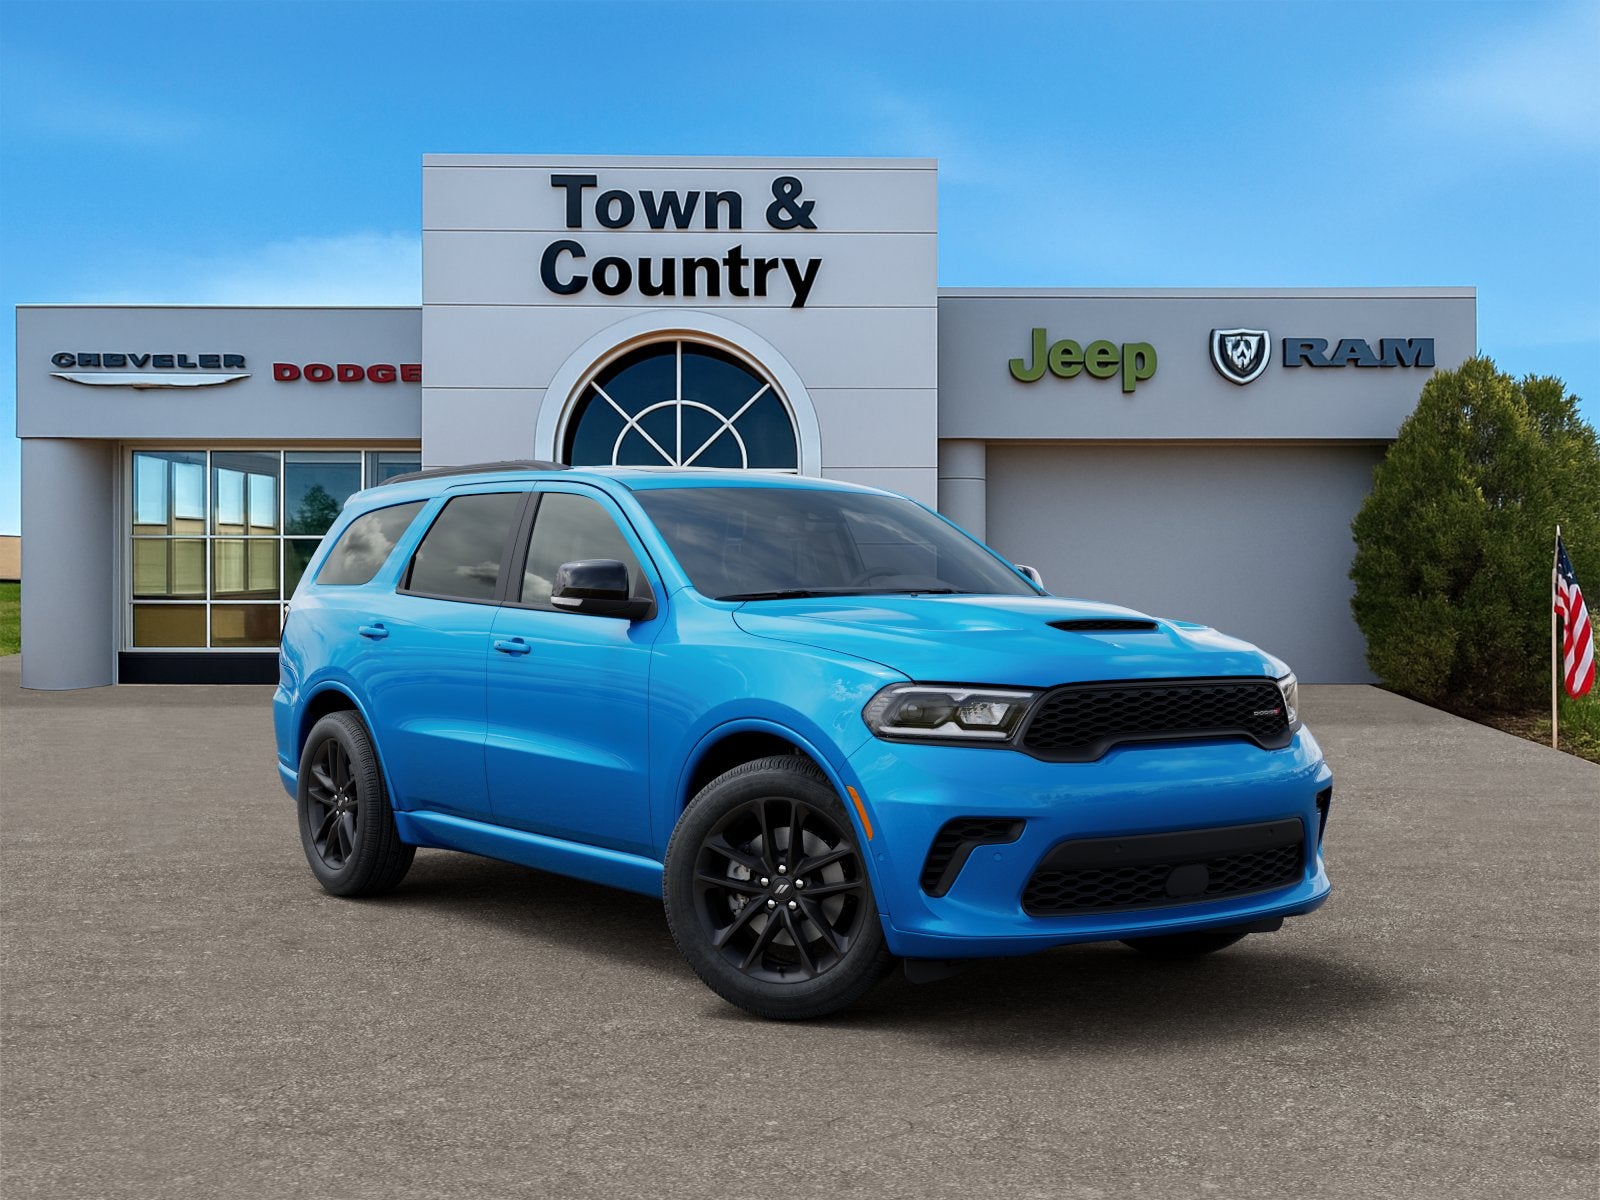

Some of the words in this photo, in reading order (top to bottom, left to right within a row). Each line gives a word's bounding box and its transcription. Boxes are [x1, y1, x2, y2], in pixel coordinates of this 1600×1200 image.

[550, 174, 743, 230] Town
[765, 175, 818, 230] &
[539, 238, 823, 308] Country
[272, 362, 422, 384] DODGE
[1009, 327, 1157, 393] Jeep
[1283, 337, 1435, 368] RAM
